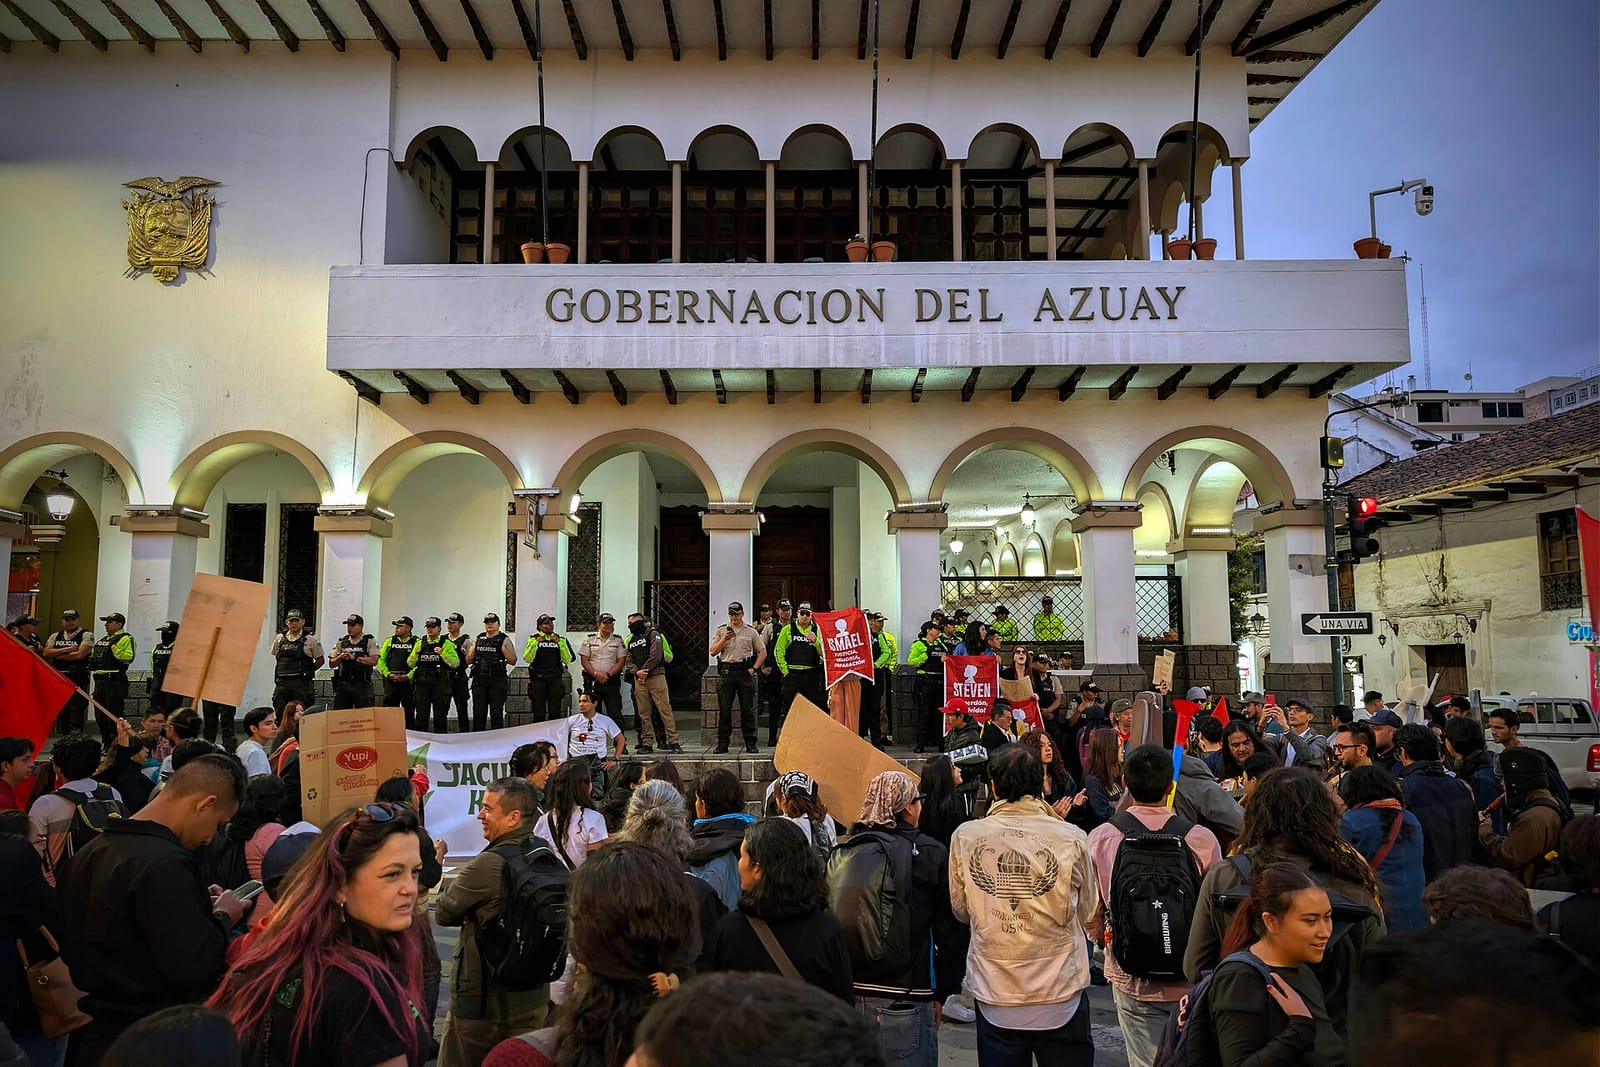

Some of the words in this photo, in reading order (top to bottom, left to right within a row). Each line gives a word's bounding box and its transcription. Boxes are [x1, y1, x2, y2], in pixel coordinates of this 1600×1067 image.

[544, 286, 885, 325] GOBERNACION
[915, 288, 1003, 323] DEL
[1034, 286, 1187, 323] AZUAY
[1321, 620, 1343, 629] UNA
[1346, 619, 1364, 628] VIA
[629, 638, 647, 649] POLICIA
[953, 682, 991, 698] STEVEN
[344, 751, 369, 762] Yupi
